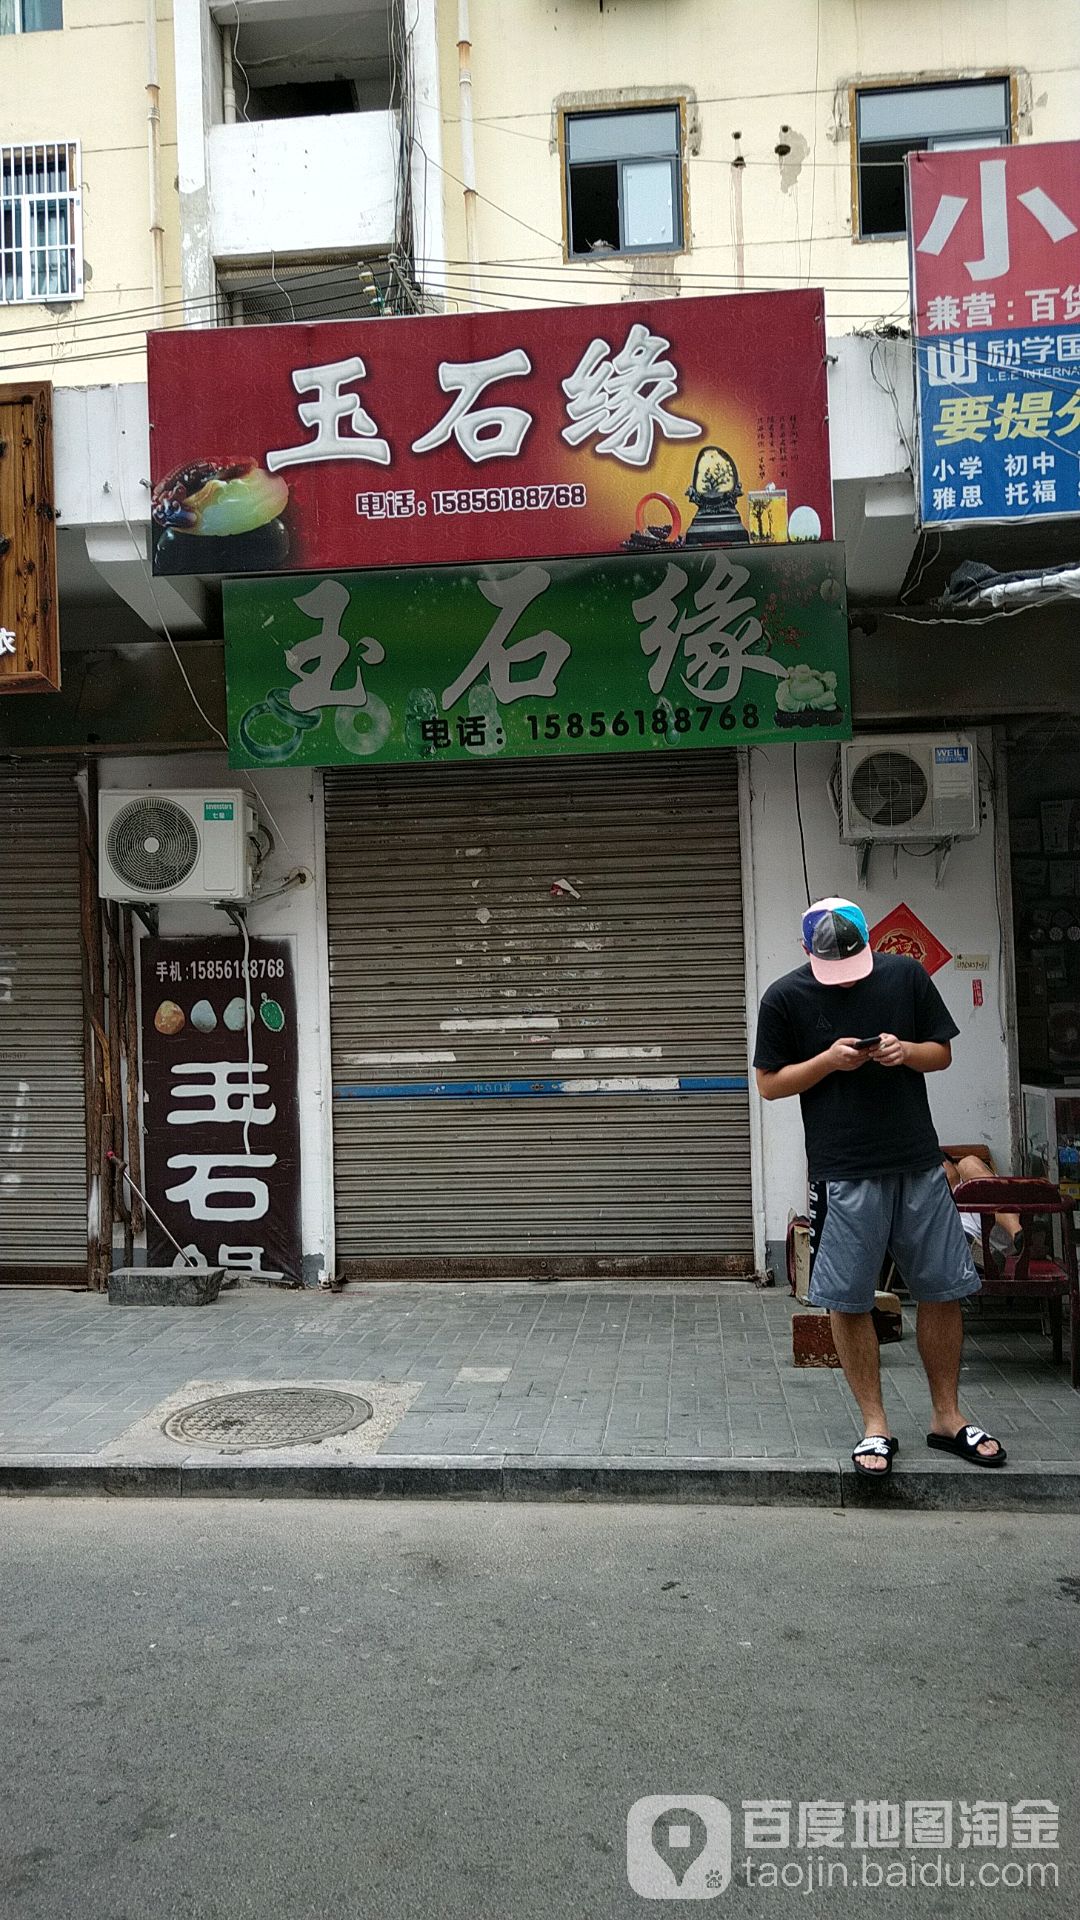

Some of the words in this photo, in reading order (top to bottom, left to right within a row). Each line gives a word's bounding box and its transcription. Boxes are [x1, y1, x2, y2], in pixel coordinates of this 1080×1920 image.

[915, 159, 1079, 281] 小
[266, 323, 703, 473] 玉石缘
[932, 456, 983, 482] 小学
[1003, 451, 1055, 478] 初中
[932, 485, 983, 511] 雅思
[1004, 479, 1057, 506] 托福
[284, 555, 788, 713] 玉石缘
